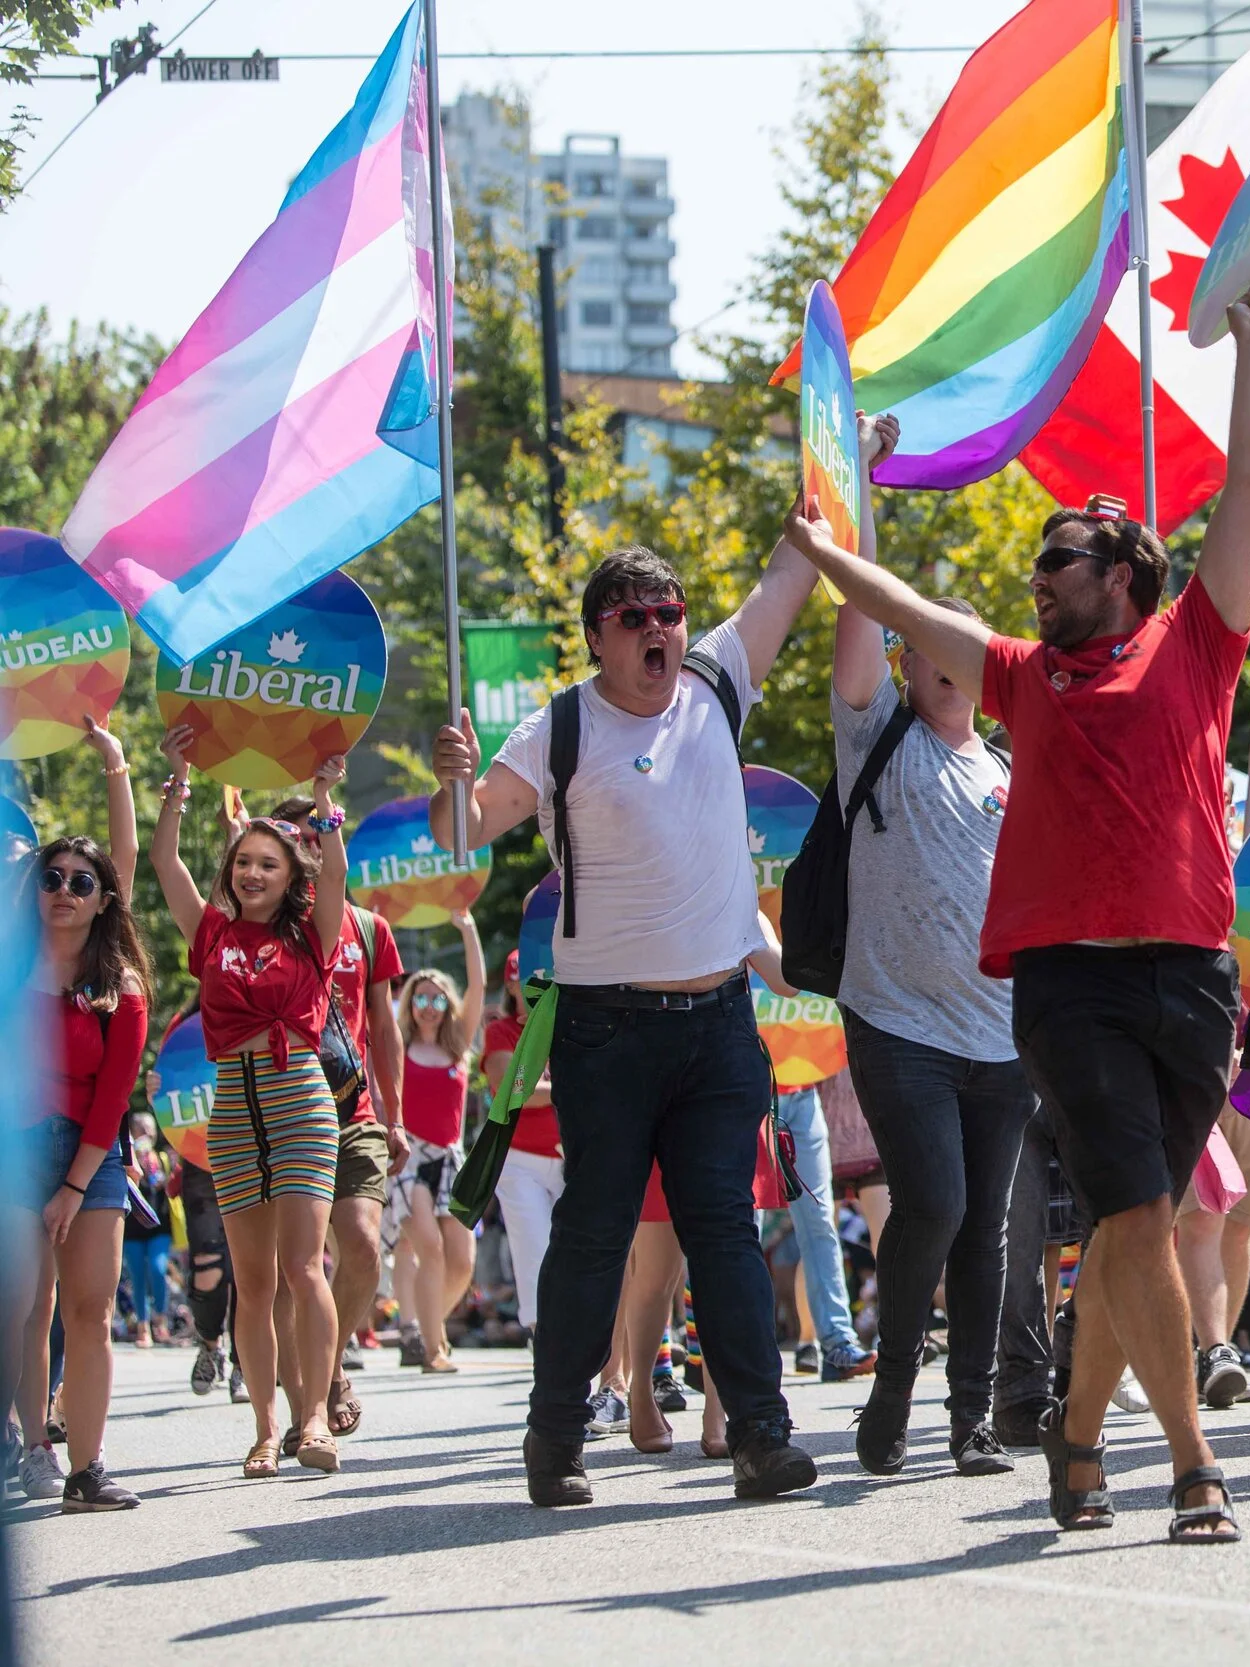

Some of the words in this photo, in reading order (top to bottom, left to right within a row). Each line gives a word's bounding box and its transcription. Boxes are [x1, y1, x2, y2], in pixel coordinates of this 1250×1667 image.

[167, 60, 230, 81] POWER
[242, 60, 271, 81] OFF
[808, 383, 856, 521] Liberal
[0, 625, 113, 672] UDEAU
[174, 650, 361, 713] Liberal
